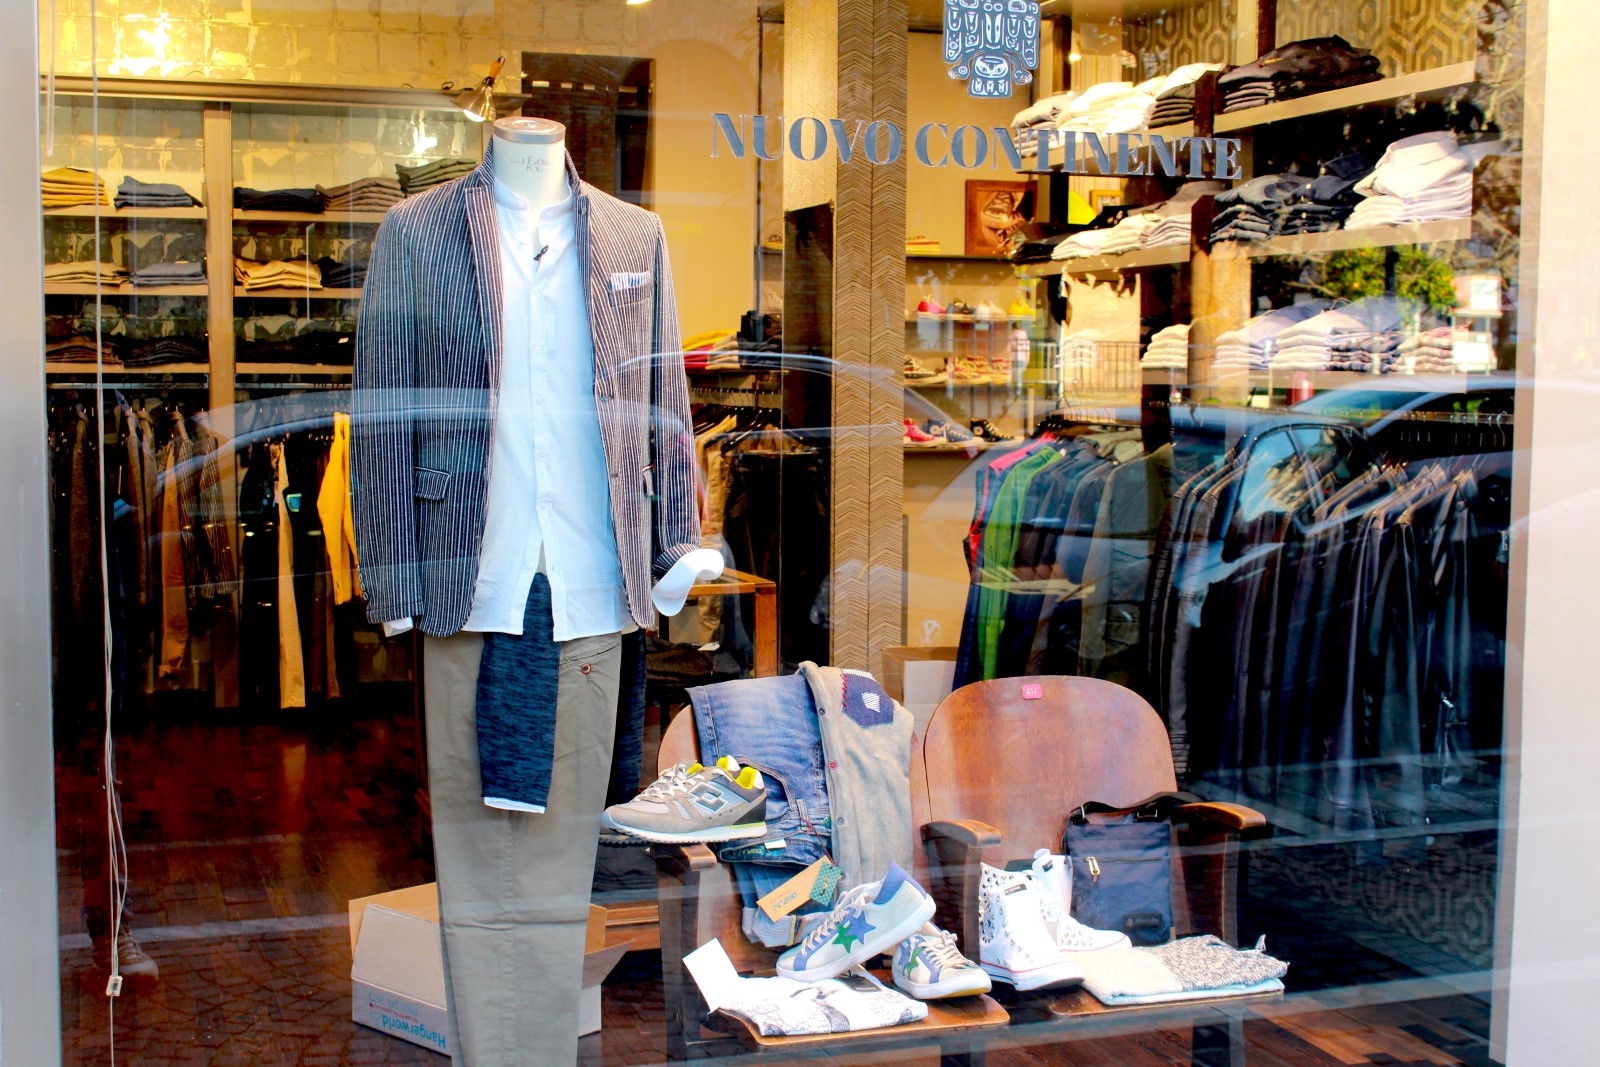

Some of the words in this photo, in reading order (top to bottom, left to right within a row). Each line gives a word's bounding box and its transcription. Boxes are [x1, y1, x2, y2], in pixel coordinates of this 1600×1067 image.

[710, 112, 902, 165] NUOVO
[914, 122, 1243, 180] CONTINENTE
[381, 1014, 447, 1049] Hangerworld
